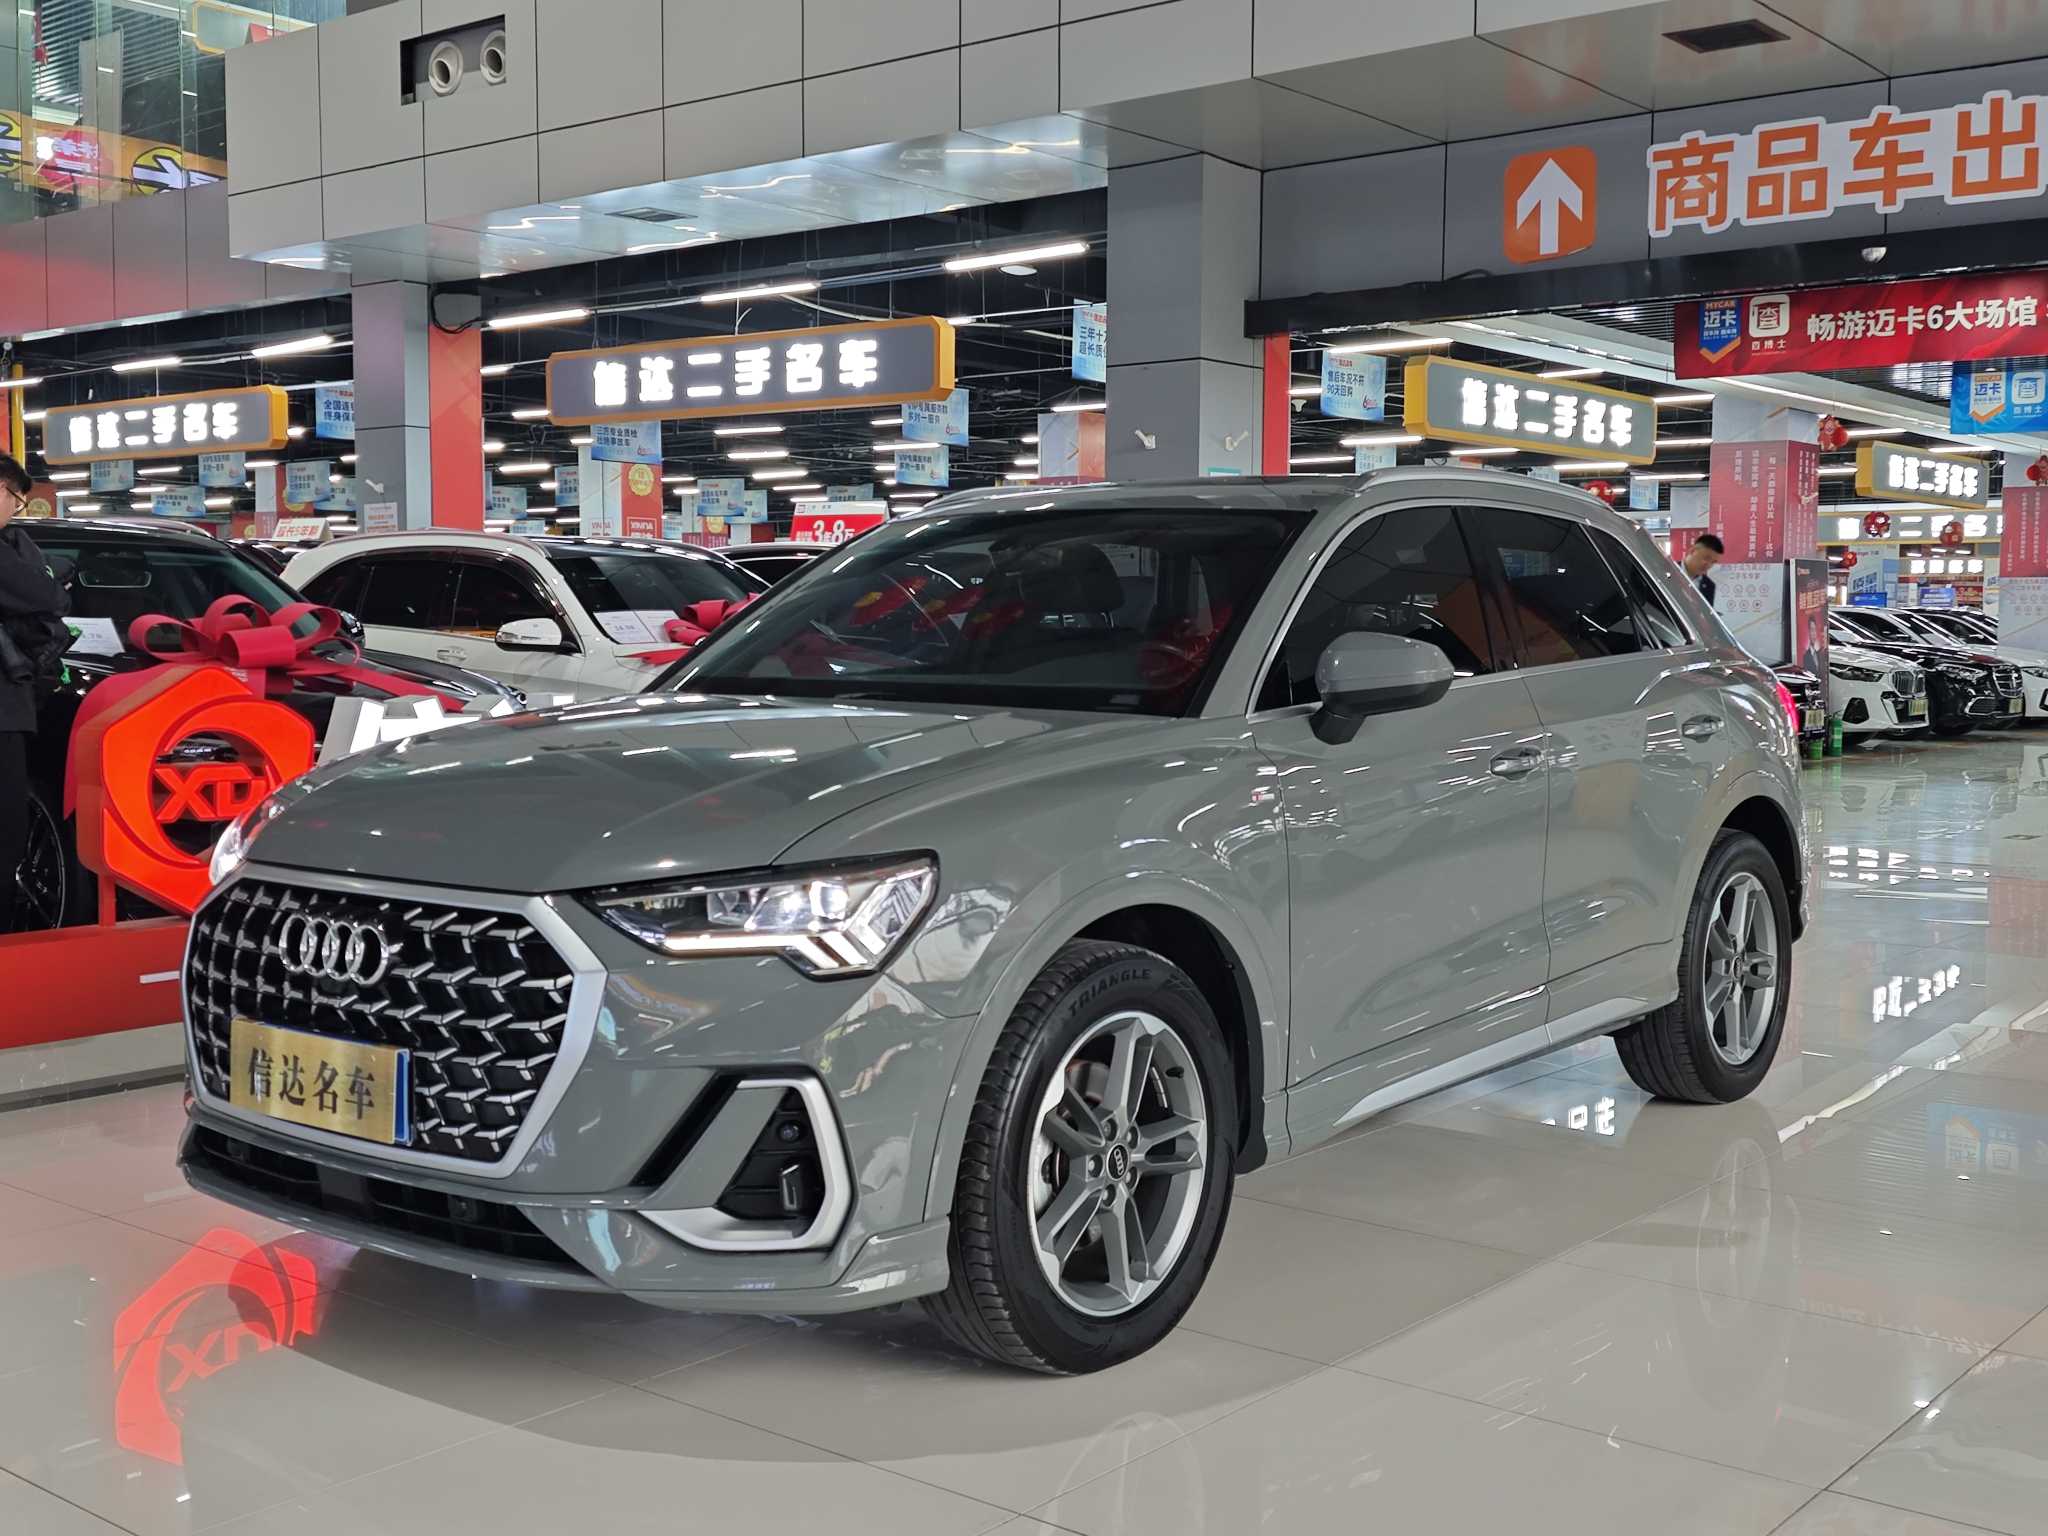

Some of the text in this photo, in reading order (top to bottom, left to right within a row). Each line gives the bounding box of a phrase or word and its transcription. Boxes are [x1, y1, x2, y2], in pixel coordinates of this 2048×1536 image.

[1651, 95, 2042, 233] 商品车出
[1703, 310, 1737, 328] 迈卡
[1807, 295, 2038, 342] 畅游迈卡6大场馆
[1975, 382, 2002, 396] 迈卡
[323, 410, 353, 422] 终身保
[1068, 967, 1152, 1017] TRIANGLE
[248, 1047, 375, 1121] 信达名车
